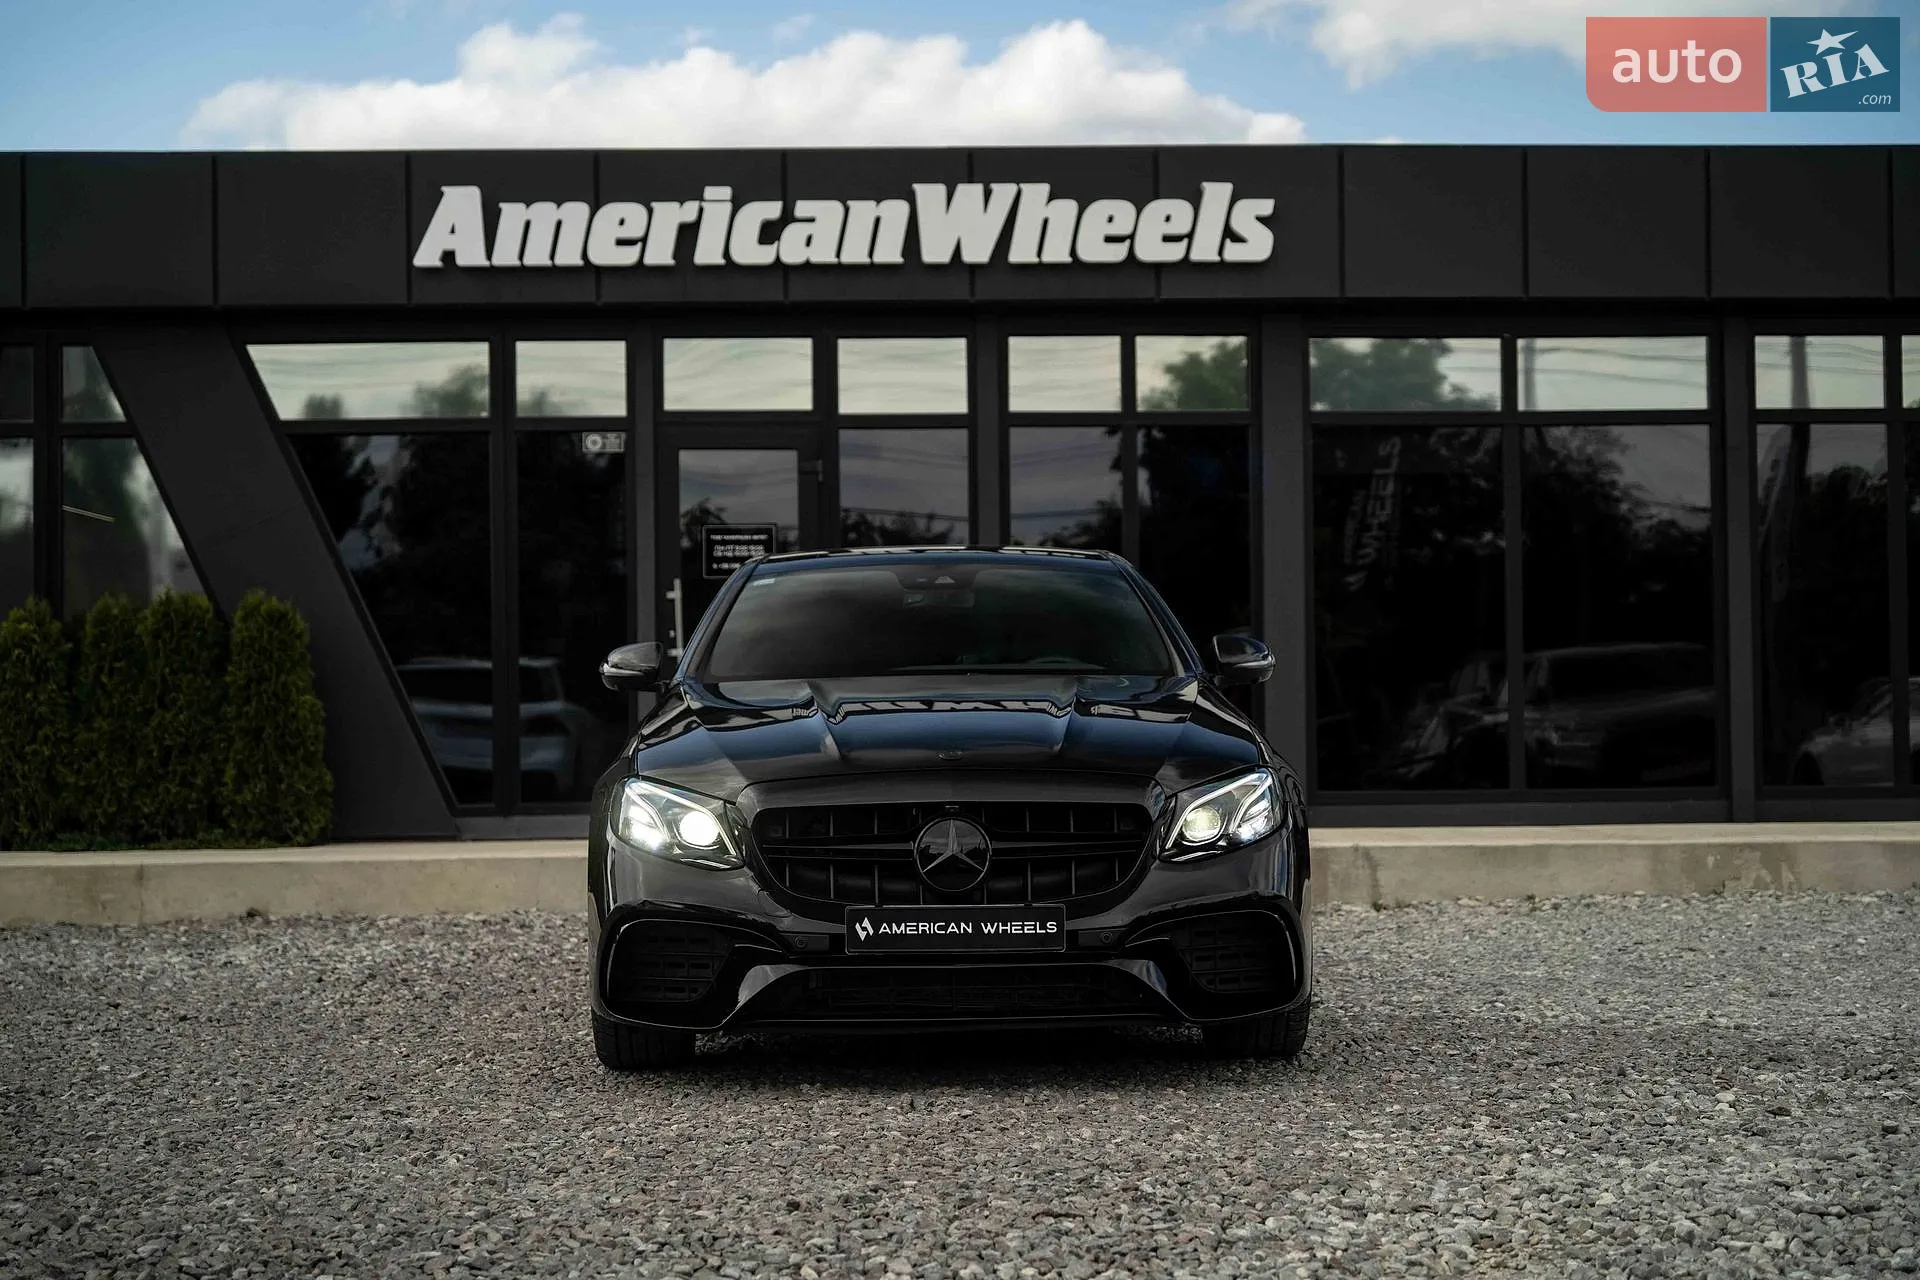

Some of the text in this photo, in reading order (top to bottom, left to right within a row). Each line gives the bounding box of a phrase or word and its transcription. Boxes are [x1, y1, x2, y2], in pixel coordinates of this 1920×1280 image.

[413, 181, 1276, 268] AmericanWheels
[878, 921, 1058, 935] AMERICAN WHEELS
